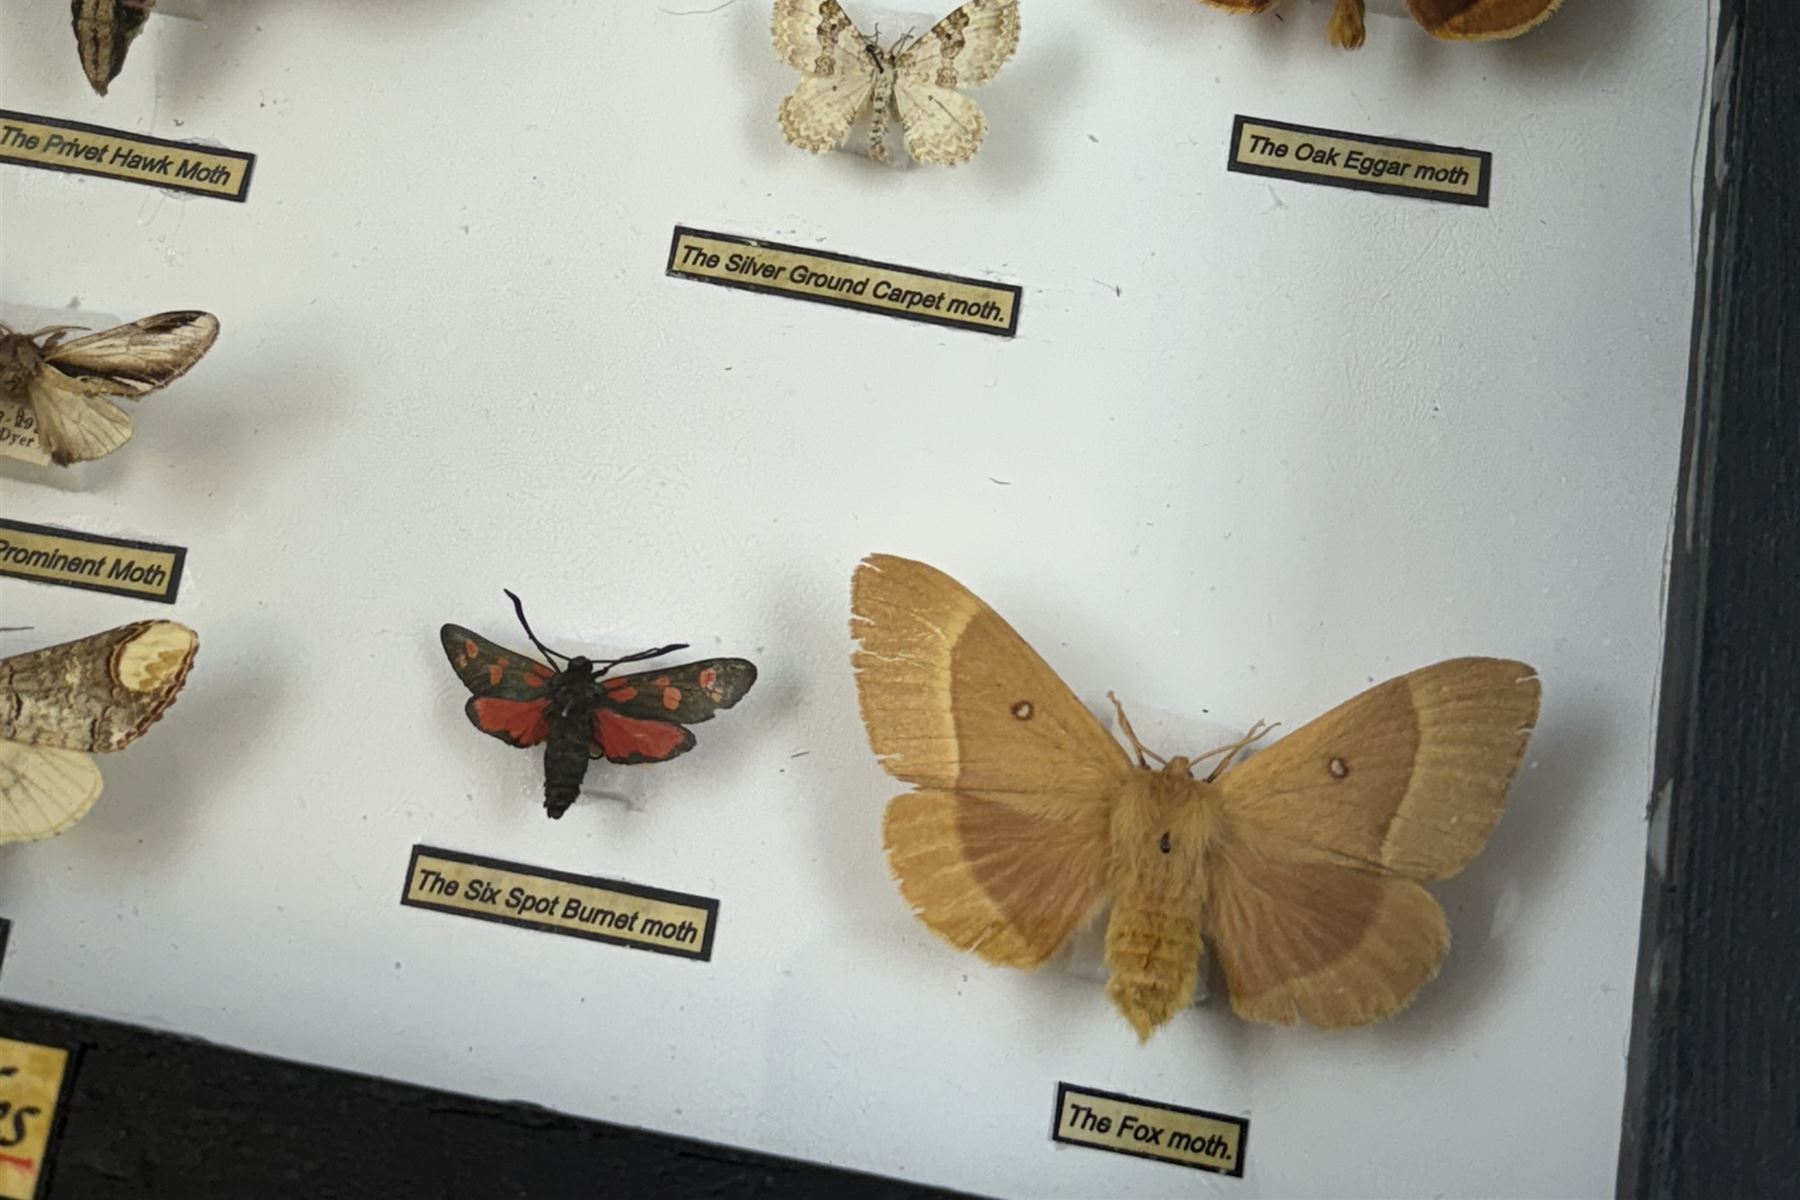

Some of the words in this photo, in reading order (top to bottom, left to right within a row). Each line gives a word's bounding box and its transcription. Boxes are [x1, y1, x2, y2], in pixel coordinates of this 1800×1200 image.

[0, 125, 40, 150] The
[43, 134, 108, 163] Privet
[109, 146, 174, 175] Hawk
[175, 159, 231, 186] Moth
[1250, 135, 1288, 157] The
[1294, 143, 1339, 166] Oak
[1343, 150, 1411, 177] Eggar
[1413, 163, 1470, 185] moth
[682, 245, 720, 268] The
[725, 255, 786, 280] Silver
[789, 270, 870, 296] Ground
[872, 281, 945, 310] Carpet
[947, 297, 1004, 322] moth.
[107, 558, 166, 587] Moth
[418, 869, 459, 897] The
[464, 879, 502, 906] Six
[505, 887, 560, 915] Spot
[562, 899, 639, 932] Burnet
[640, 916, 698, 944] moth
[1069, 1104, 1112, 1133] The
[1117, 1115, 1166, 1145] Fox
[1167, 1131, 1232, 1161] moth.
